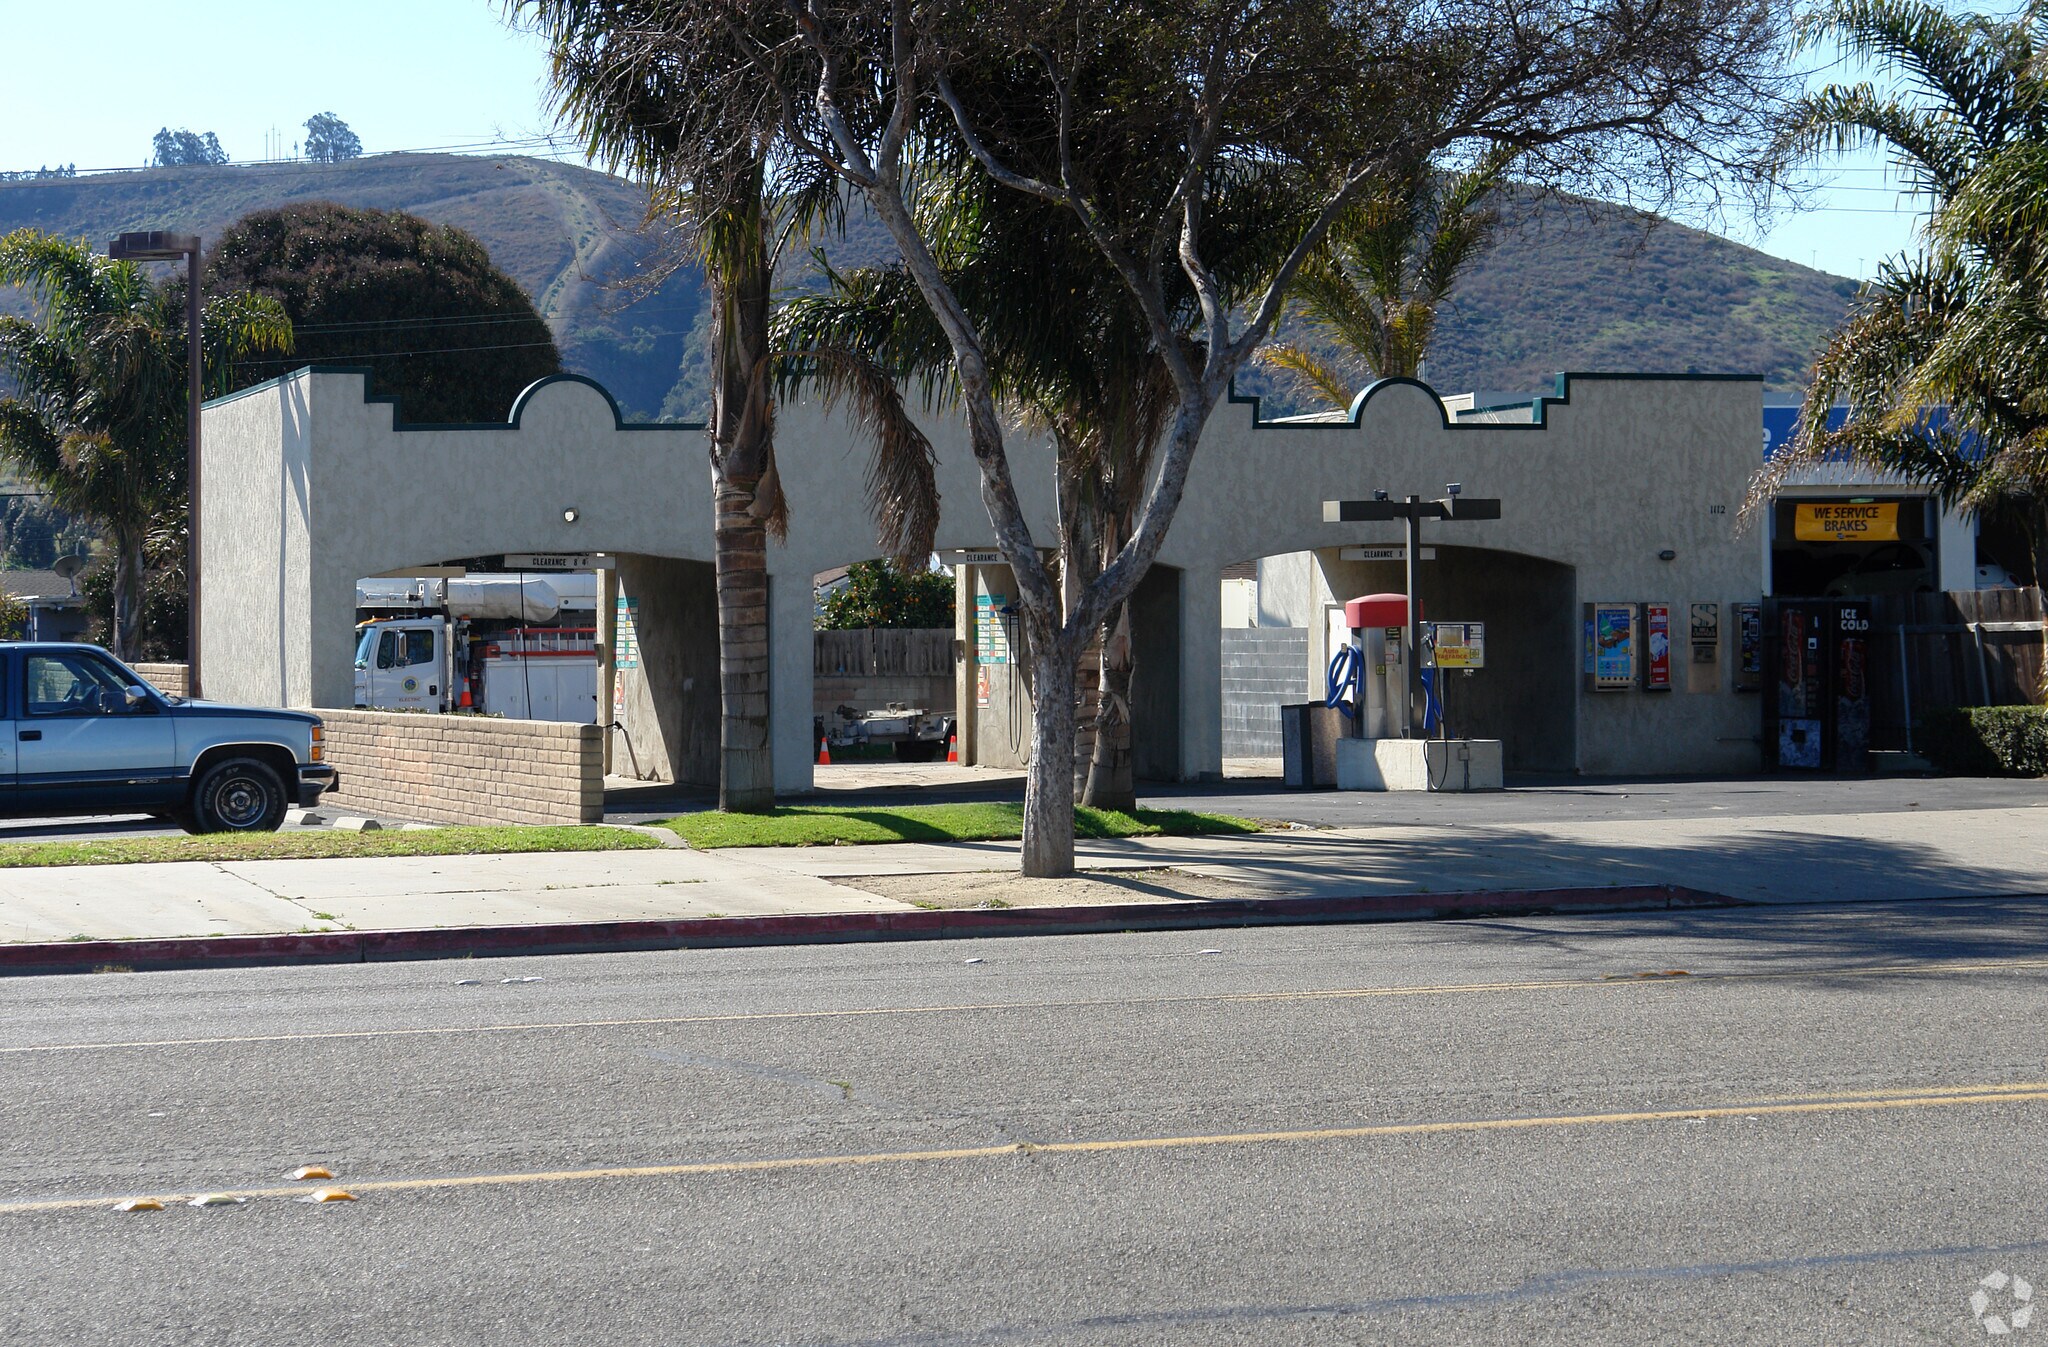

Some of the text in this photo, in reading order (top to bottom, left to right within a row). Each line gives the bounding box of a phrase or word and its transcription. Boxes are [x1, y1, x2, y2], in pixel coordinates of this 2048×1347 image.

[1710, 505, 1726, 514] 1112
[1814, 506, 1880, 519] WE SERVICE
[1824, 519, 1868, 532] BRAKES
[966, 554, 998, 562] CLEARANCE
[1364, 550, 1393, 558] CLEARANCE
[532, 558, 566, 566] CLEARANCE
[1840, 608, 1857, 619] ICE
[1840, 619, 1869, 631] COLD
